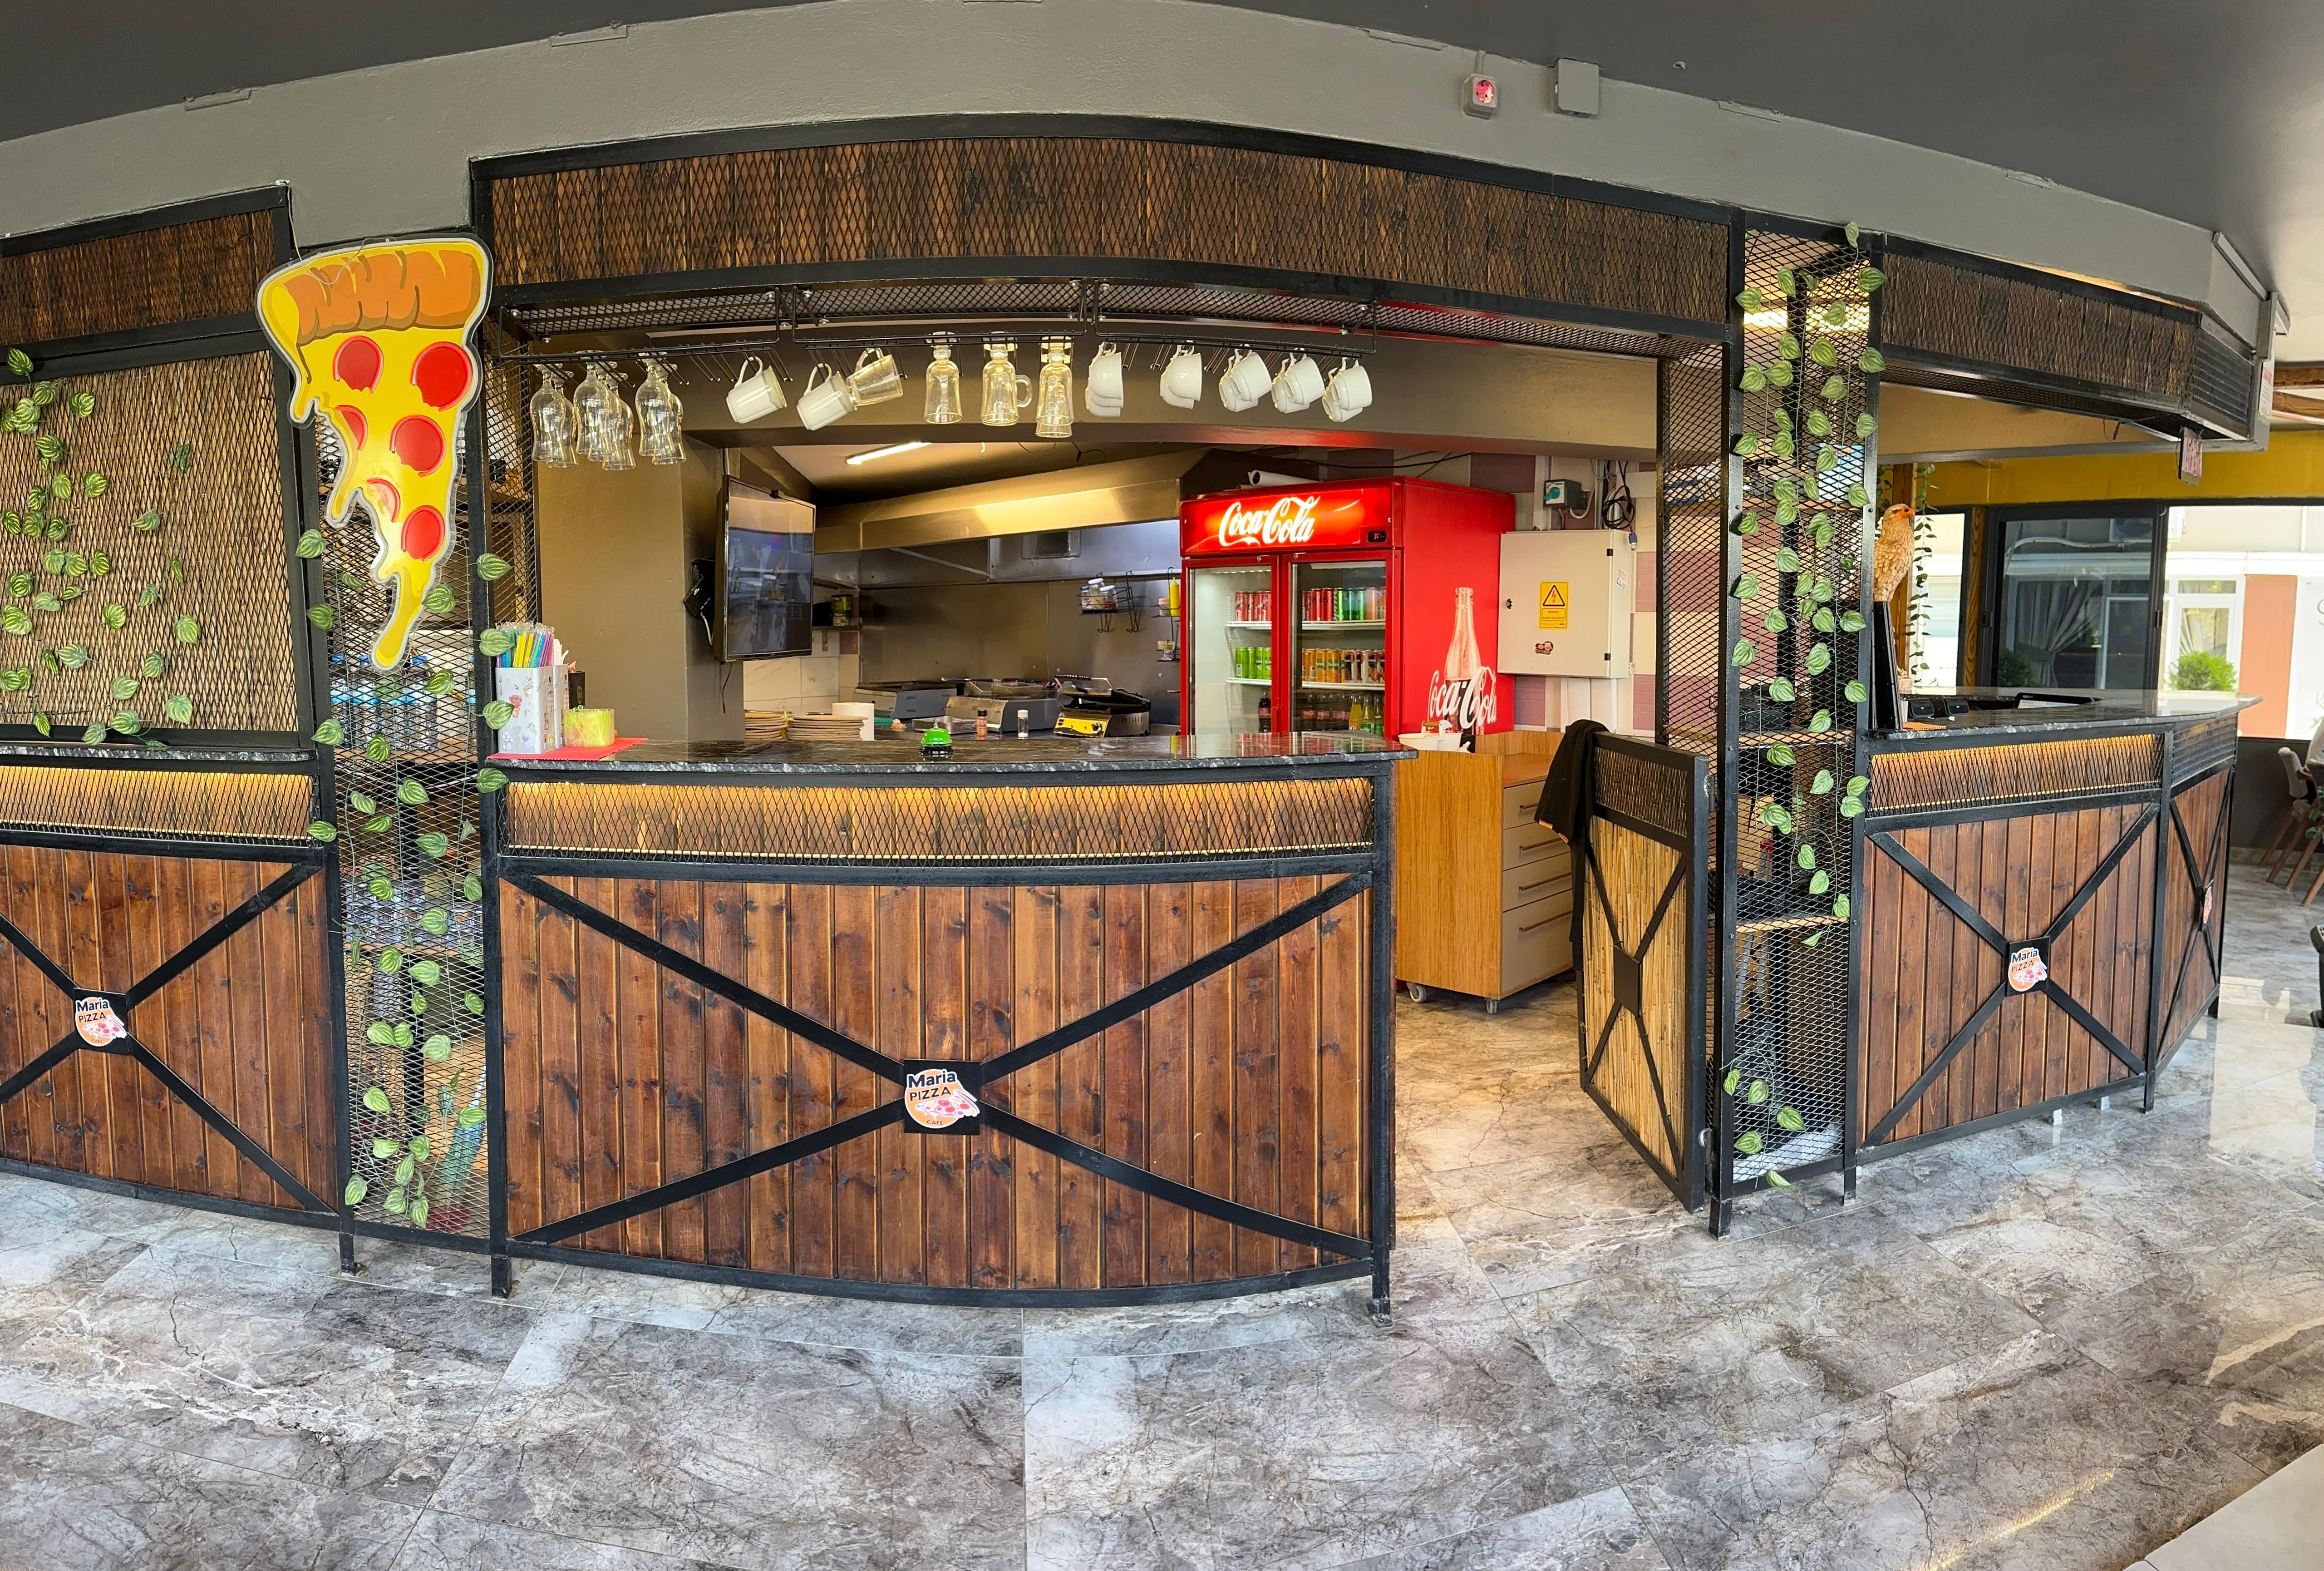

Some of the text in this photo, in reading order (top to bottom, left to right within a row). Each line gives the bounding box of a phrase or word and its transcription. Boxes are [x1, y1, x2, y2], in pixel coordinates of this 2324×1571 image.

[1219, 495, 1320, 547] Coca-Cola
[1428, 666, 1497, 729] Coca-Cola
[2012, 949, 2038, 963] Maria
[2011, 960, 2034, 973] PIZZA
[77, 999, 109, 1012] Maria
[79, 1012, 106, 1023] PIZZA
[908, 1070, 956, 1088] Maria
[910, 1086, 951, 1101] PIZZA
